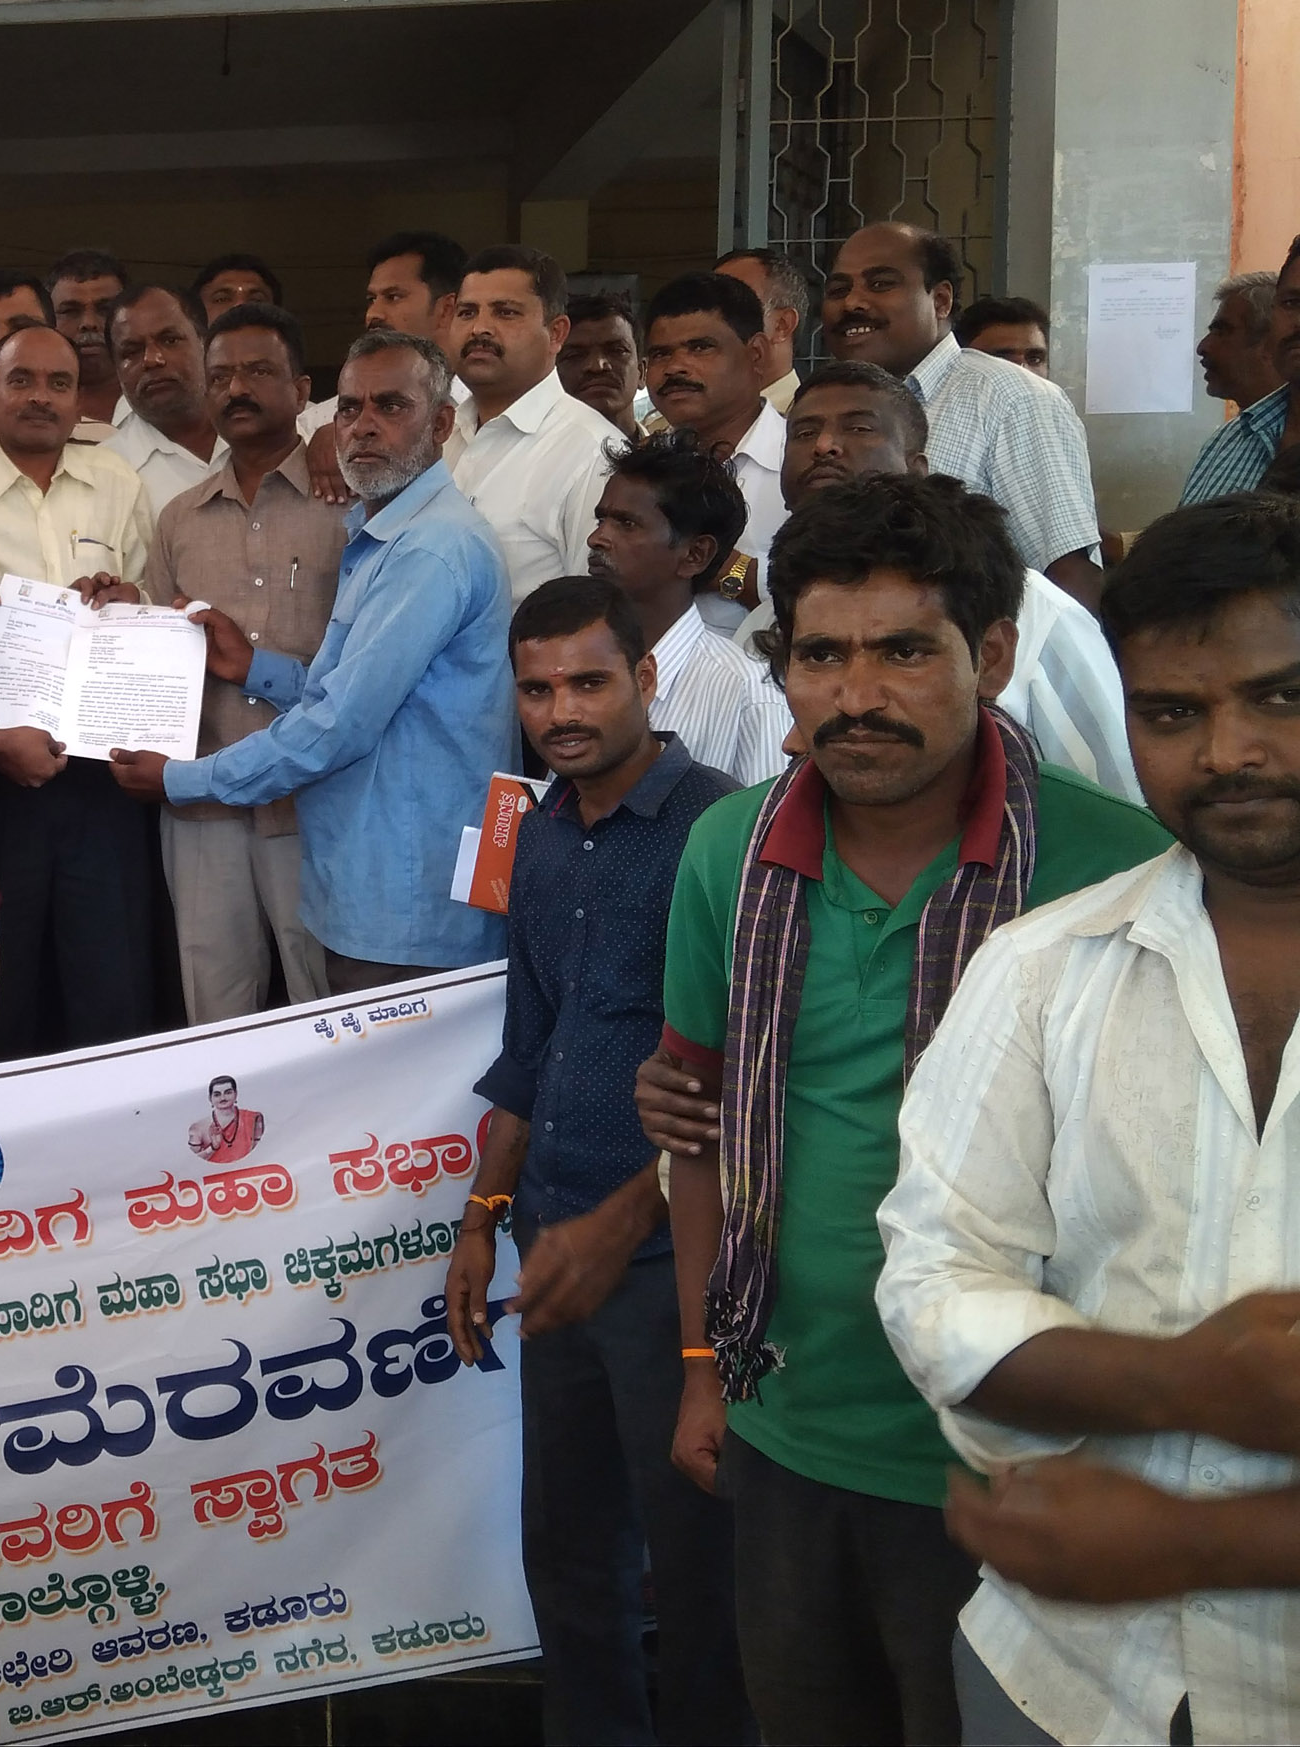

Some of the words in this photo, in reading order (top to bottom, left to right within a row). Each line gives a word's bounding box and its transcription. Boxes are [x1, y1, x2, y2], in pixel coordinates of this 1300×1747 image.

[314, 1017, 334, 1038] ಜೈ
[341, 1012, 361, 1033] ಜೈ
[367, 997, 428, 1023] ಮಾದಿಗ
[124, 1162, 295, 1230] ಮಹಾ
[97, 1271, 181, 1317] ಮಹಾ
[196, 1254, 268, 1300] ಸಭಾ
[283, 1217, 466, 1298] ಚಿಕ್ಕಮಗಳೂ
[190, 1429, 381, 1539] ಸ್ವಾಗತ
[91, 1619, 208, 1664] ಆವರಣ,
[224, 1582, 348, 1633] ಕಡೂರು
[372, 1611, 487, 1655] ಕಡೂರು
